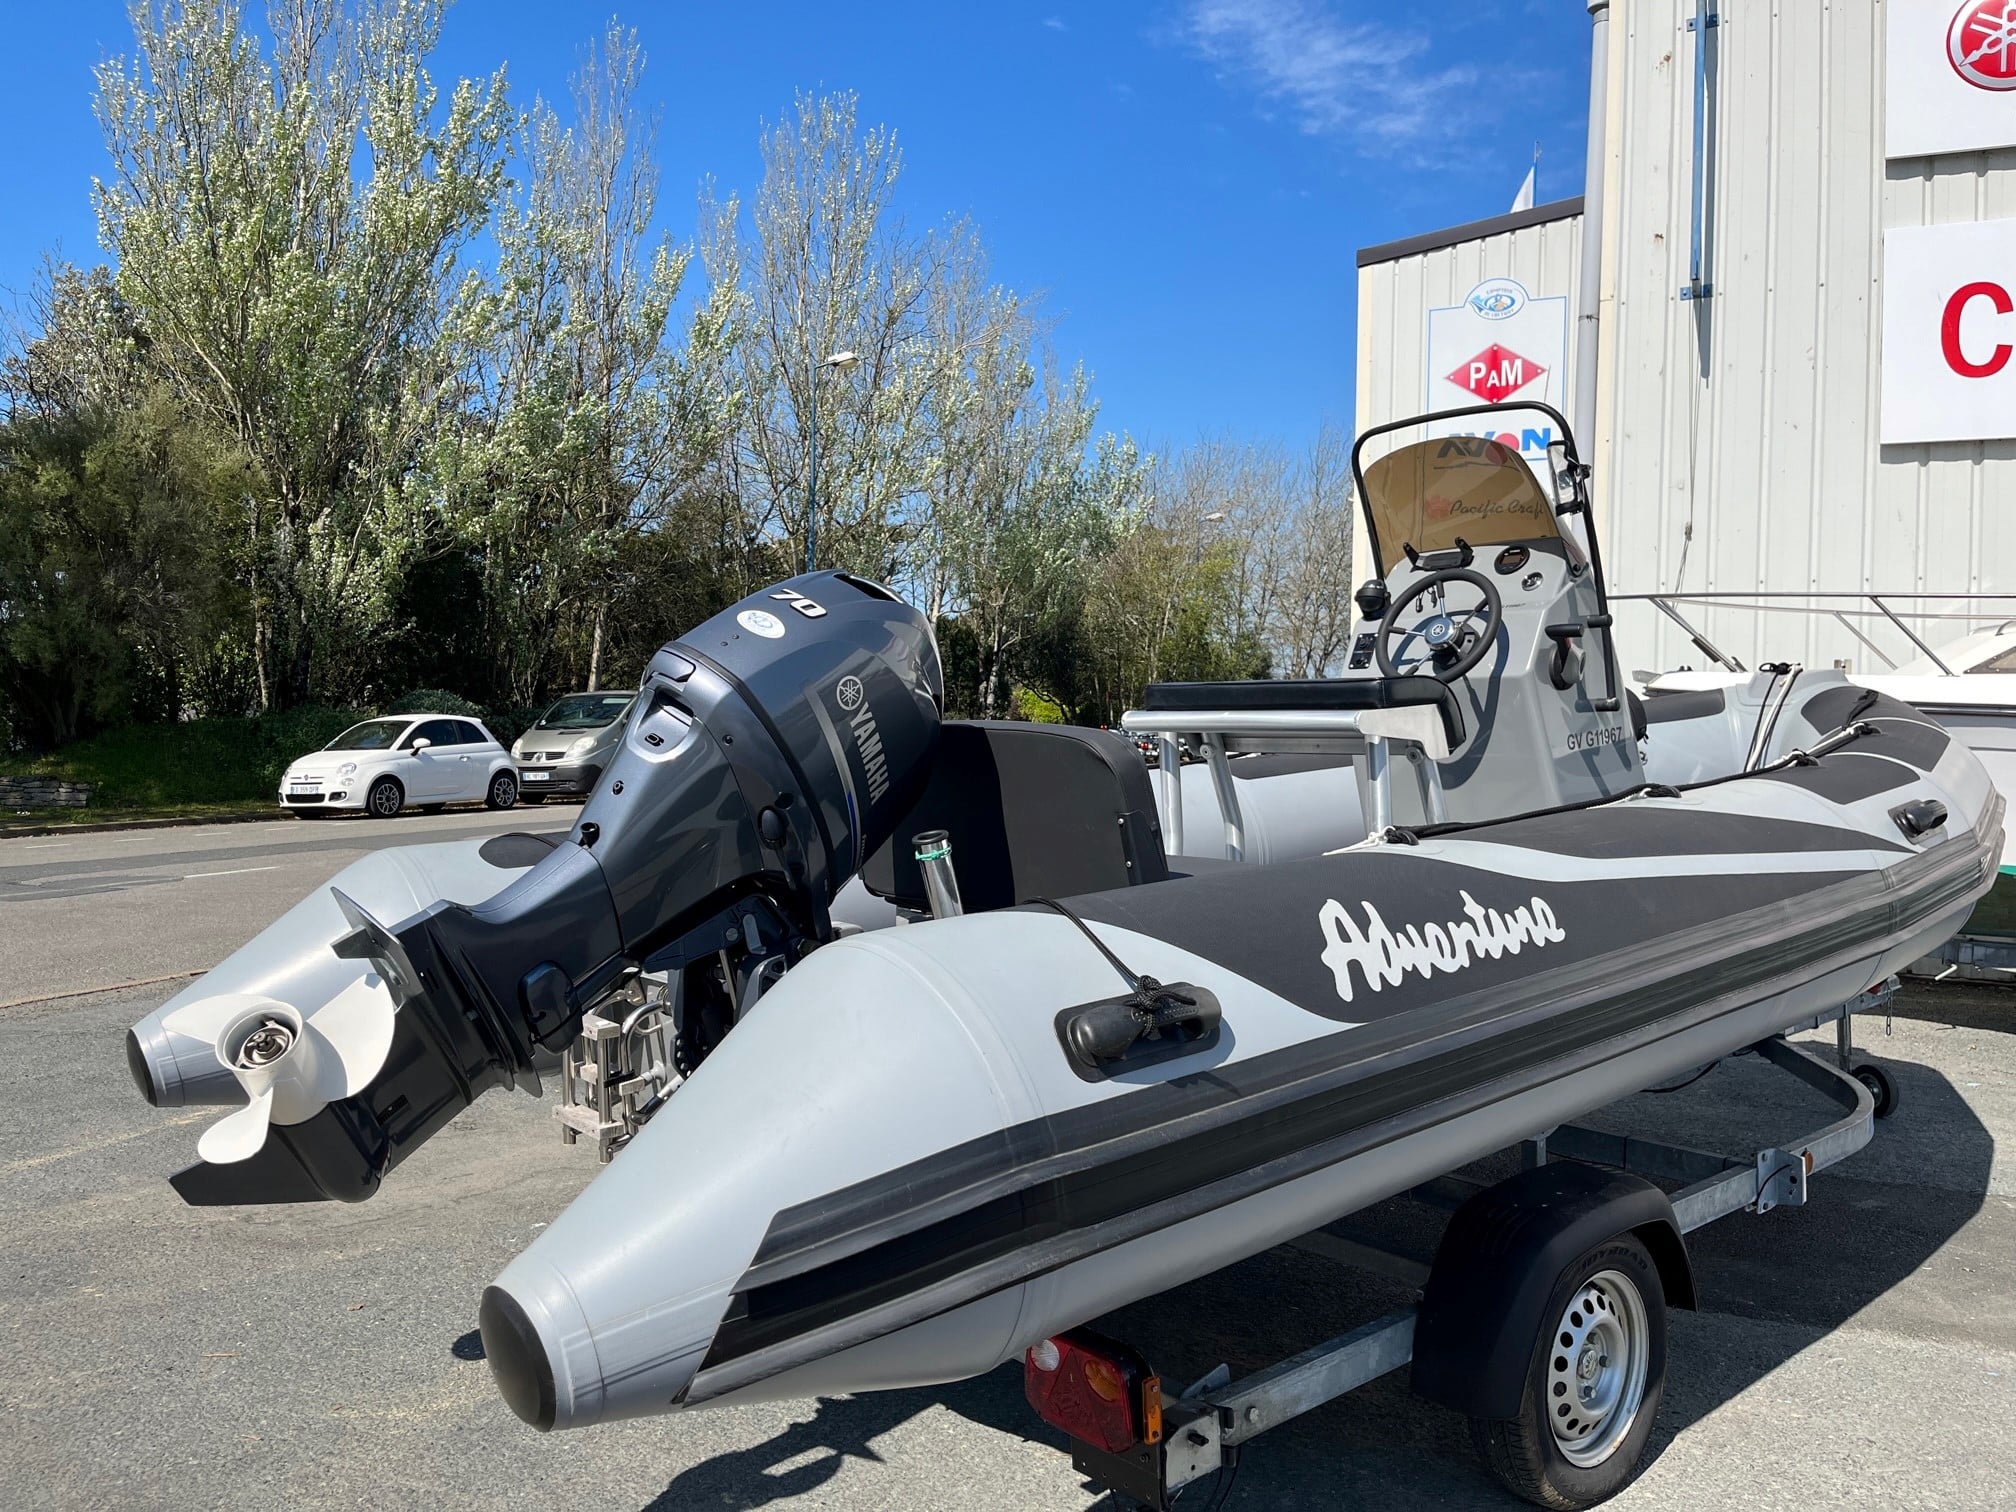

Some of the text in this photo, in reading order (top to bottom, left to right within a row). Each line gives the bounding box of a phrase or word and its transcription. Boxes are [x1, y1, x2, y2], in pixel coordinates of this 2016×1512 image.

[1450, 499, 1504, 519] Pacific
[768, 588, 828, 618] 70
[1567, 727, 1622, 750] GV G11967
[850, 702, 890, 805] YAMAHA
